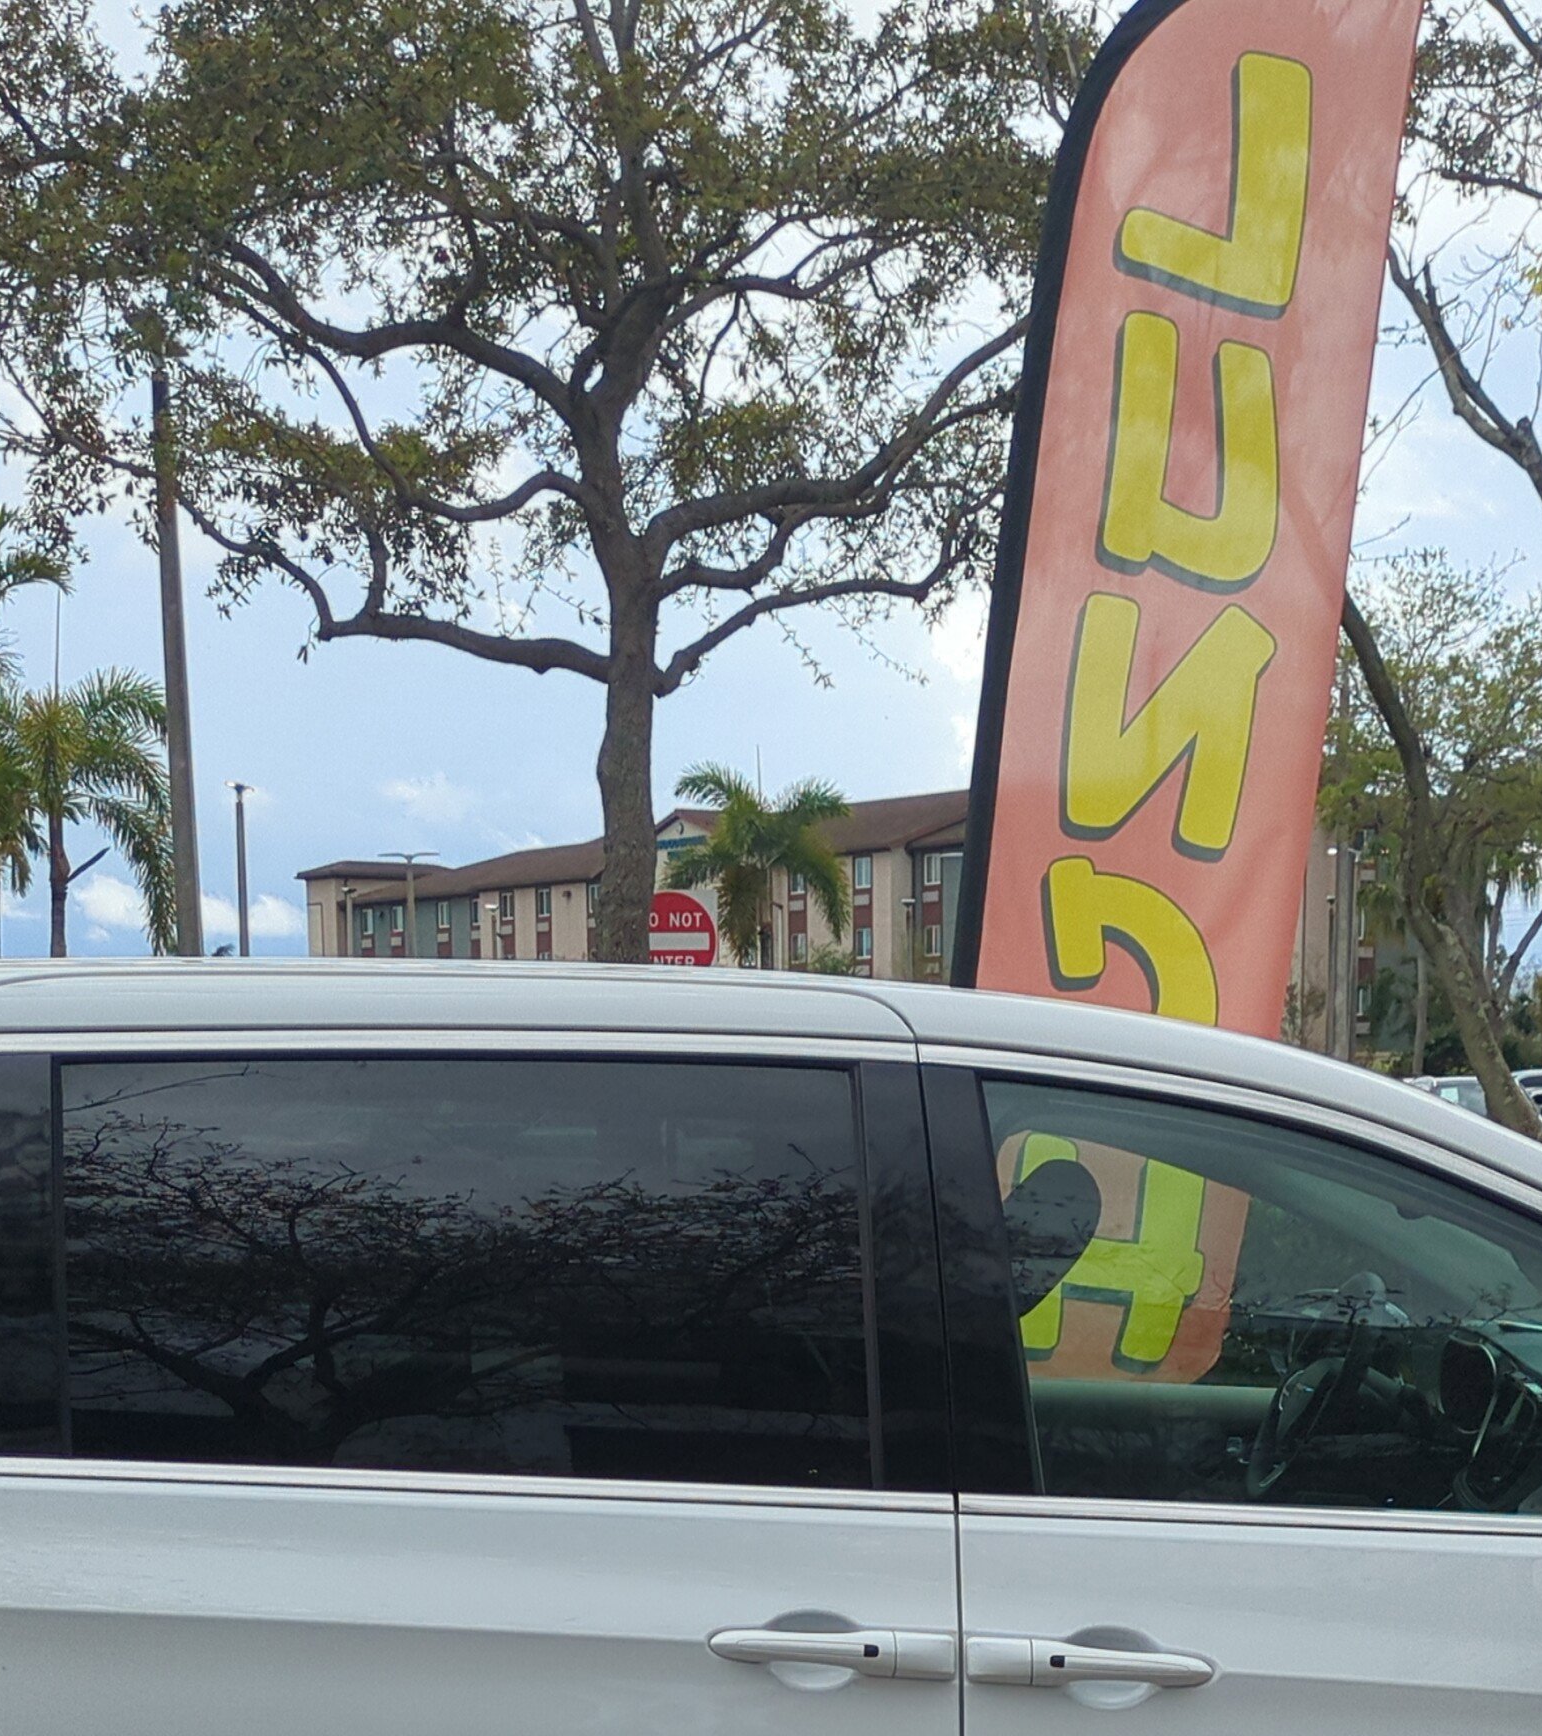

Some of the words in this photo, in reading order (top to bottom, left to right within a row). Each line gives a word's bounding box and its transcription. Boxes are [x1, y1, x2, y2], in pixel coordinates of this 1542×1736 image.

[649, 912, 659, 927] O
[669, 912, 703, 927] NOT
[649, 955, 695, 965] NTER
